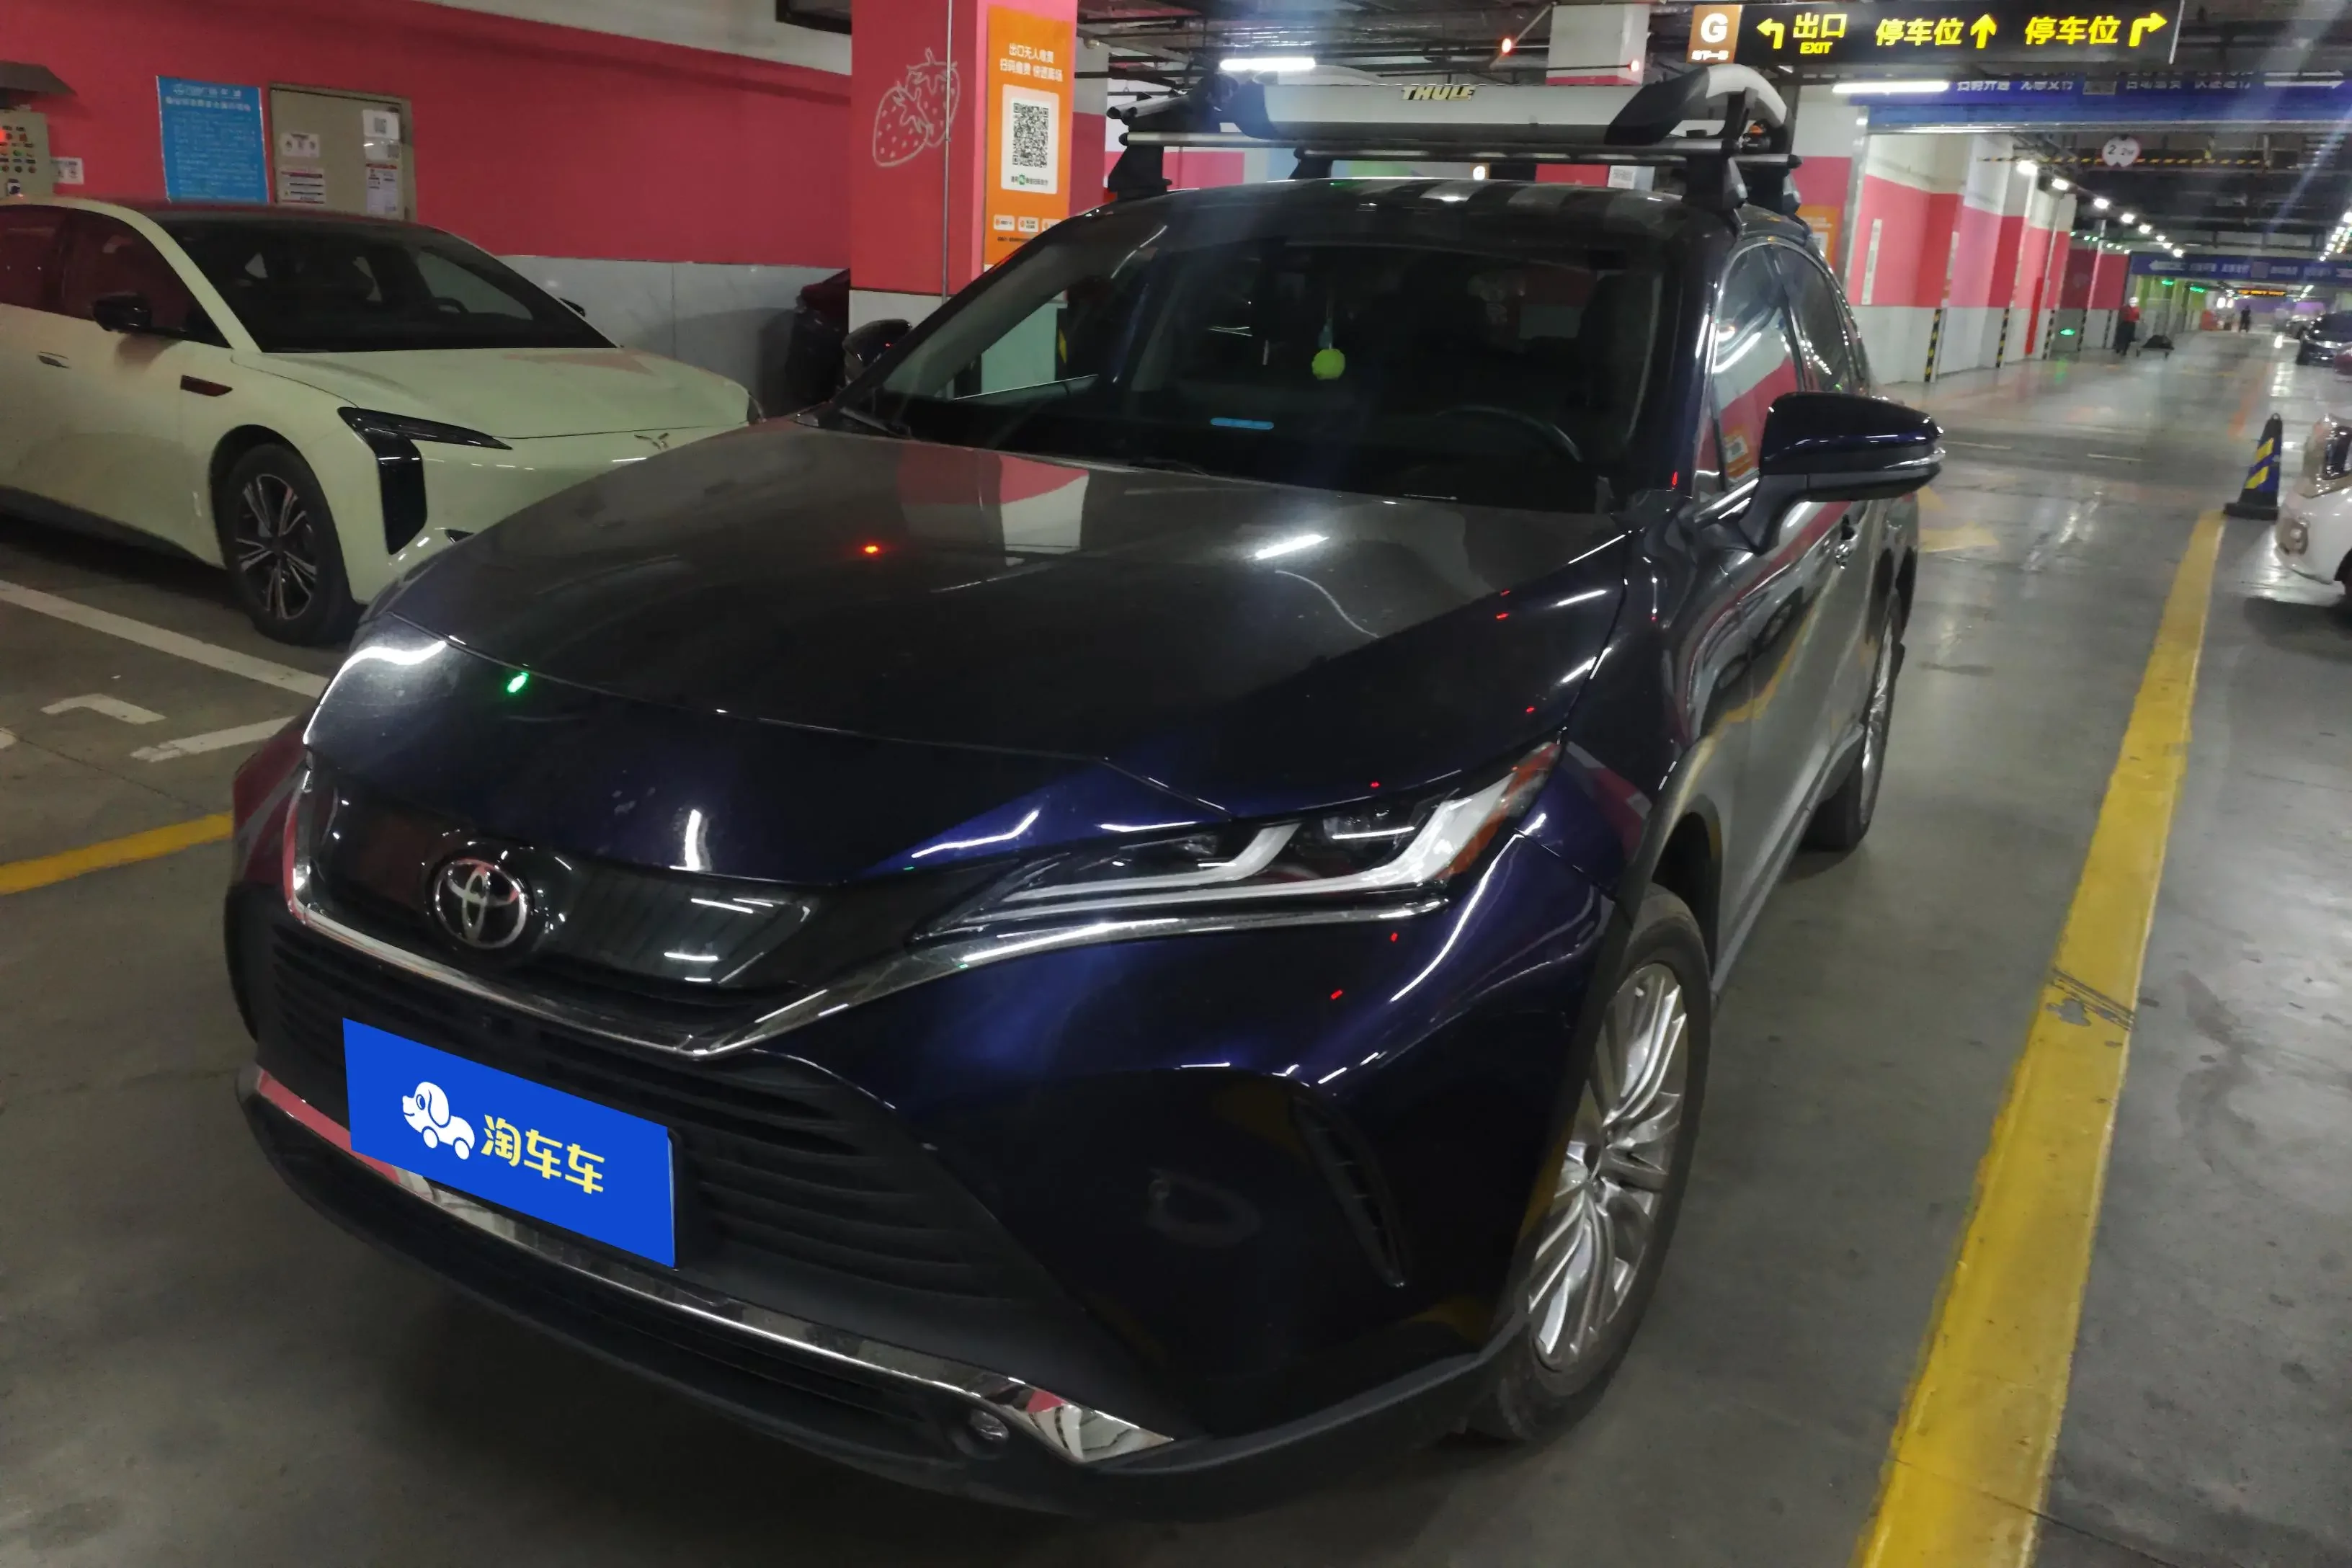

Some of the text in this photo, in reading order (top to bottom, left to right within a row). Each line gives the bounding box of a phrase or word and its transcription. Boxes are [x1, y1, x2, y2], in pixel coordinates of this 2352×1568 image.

[1701, 13, 1729, 43] G
[1793, 12, 1848, 38] 出口
[1876, 17, 1965, 46] 停车位
[2025, 16, 2121, 45] 停车位
[1800, 41, 1834, 54] EXIT
[1401, 86, 1476, 101] THULE
